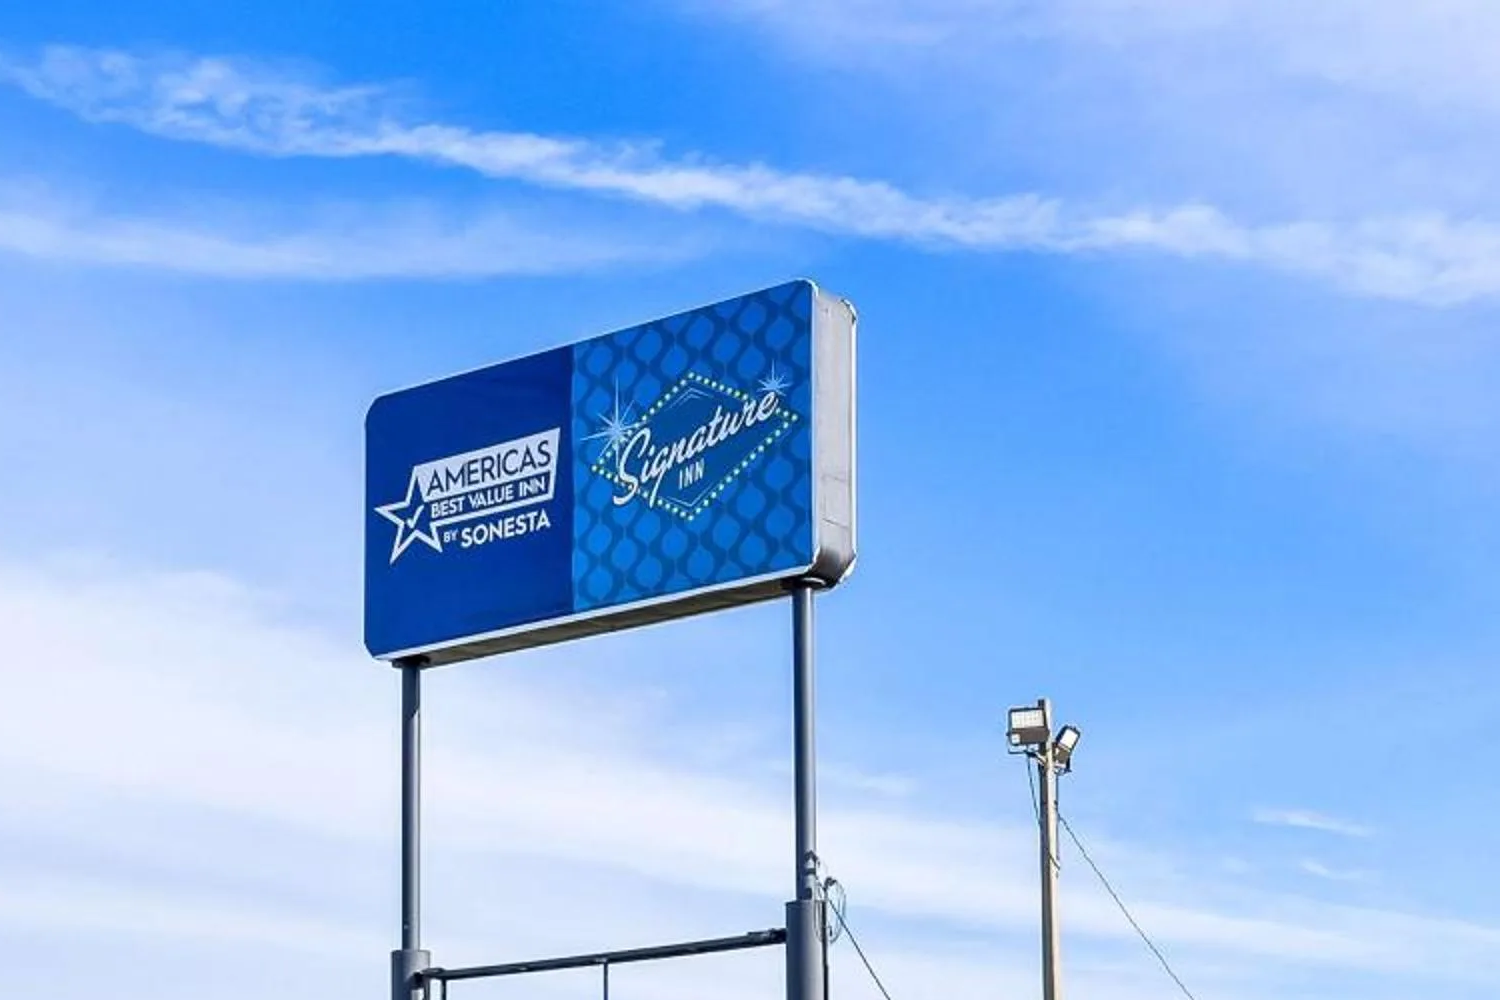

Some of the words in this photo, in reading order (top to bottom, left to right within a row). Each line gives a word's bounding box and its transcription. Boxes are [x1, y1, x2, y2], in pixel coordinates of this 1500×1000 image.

[426, 440, 551, 497] AMERICAS
[612, 391, 779, 508] Signature
[678, 458, 705, 490] INN
[431, 495, 466, 519] BEST
[468, 485, 514, 508] VALUE
[519, 476, 546, 497] INN
[443, 528, 458, 543] BY
[461, 509, 551, 548] SONESTA
